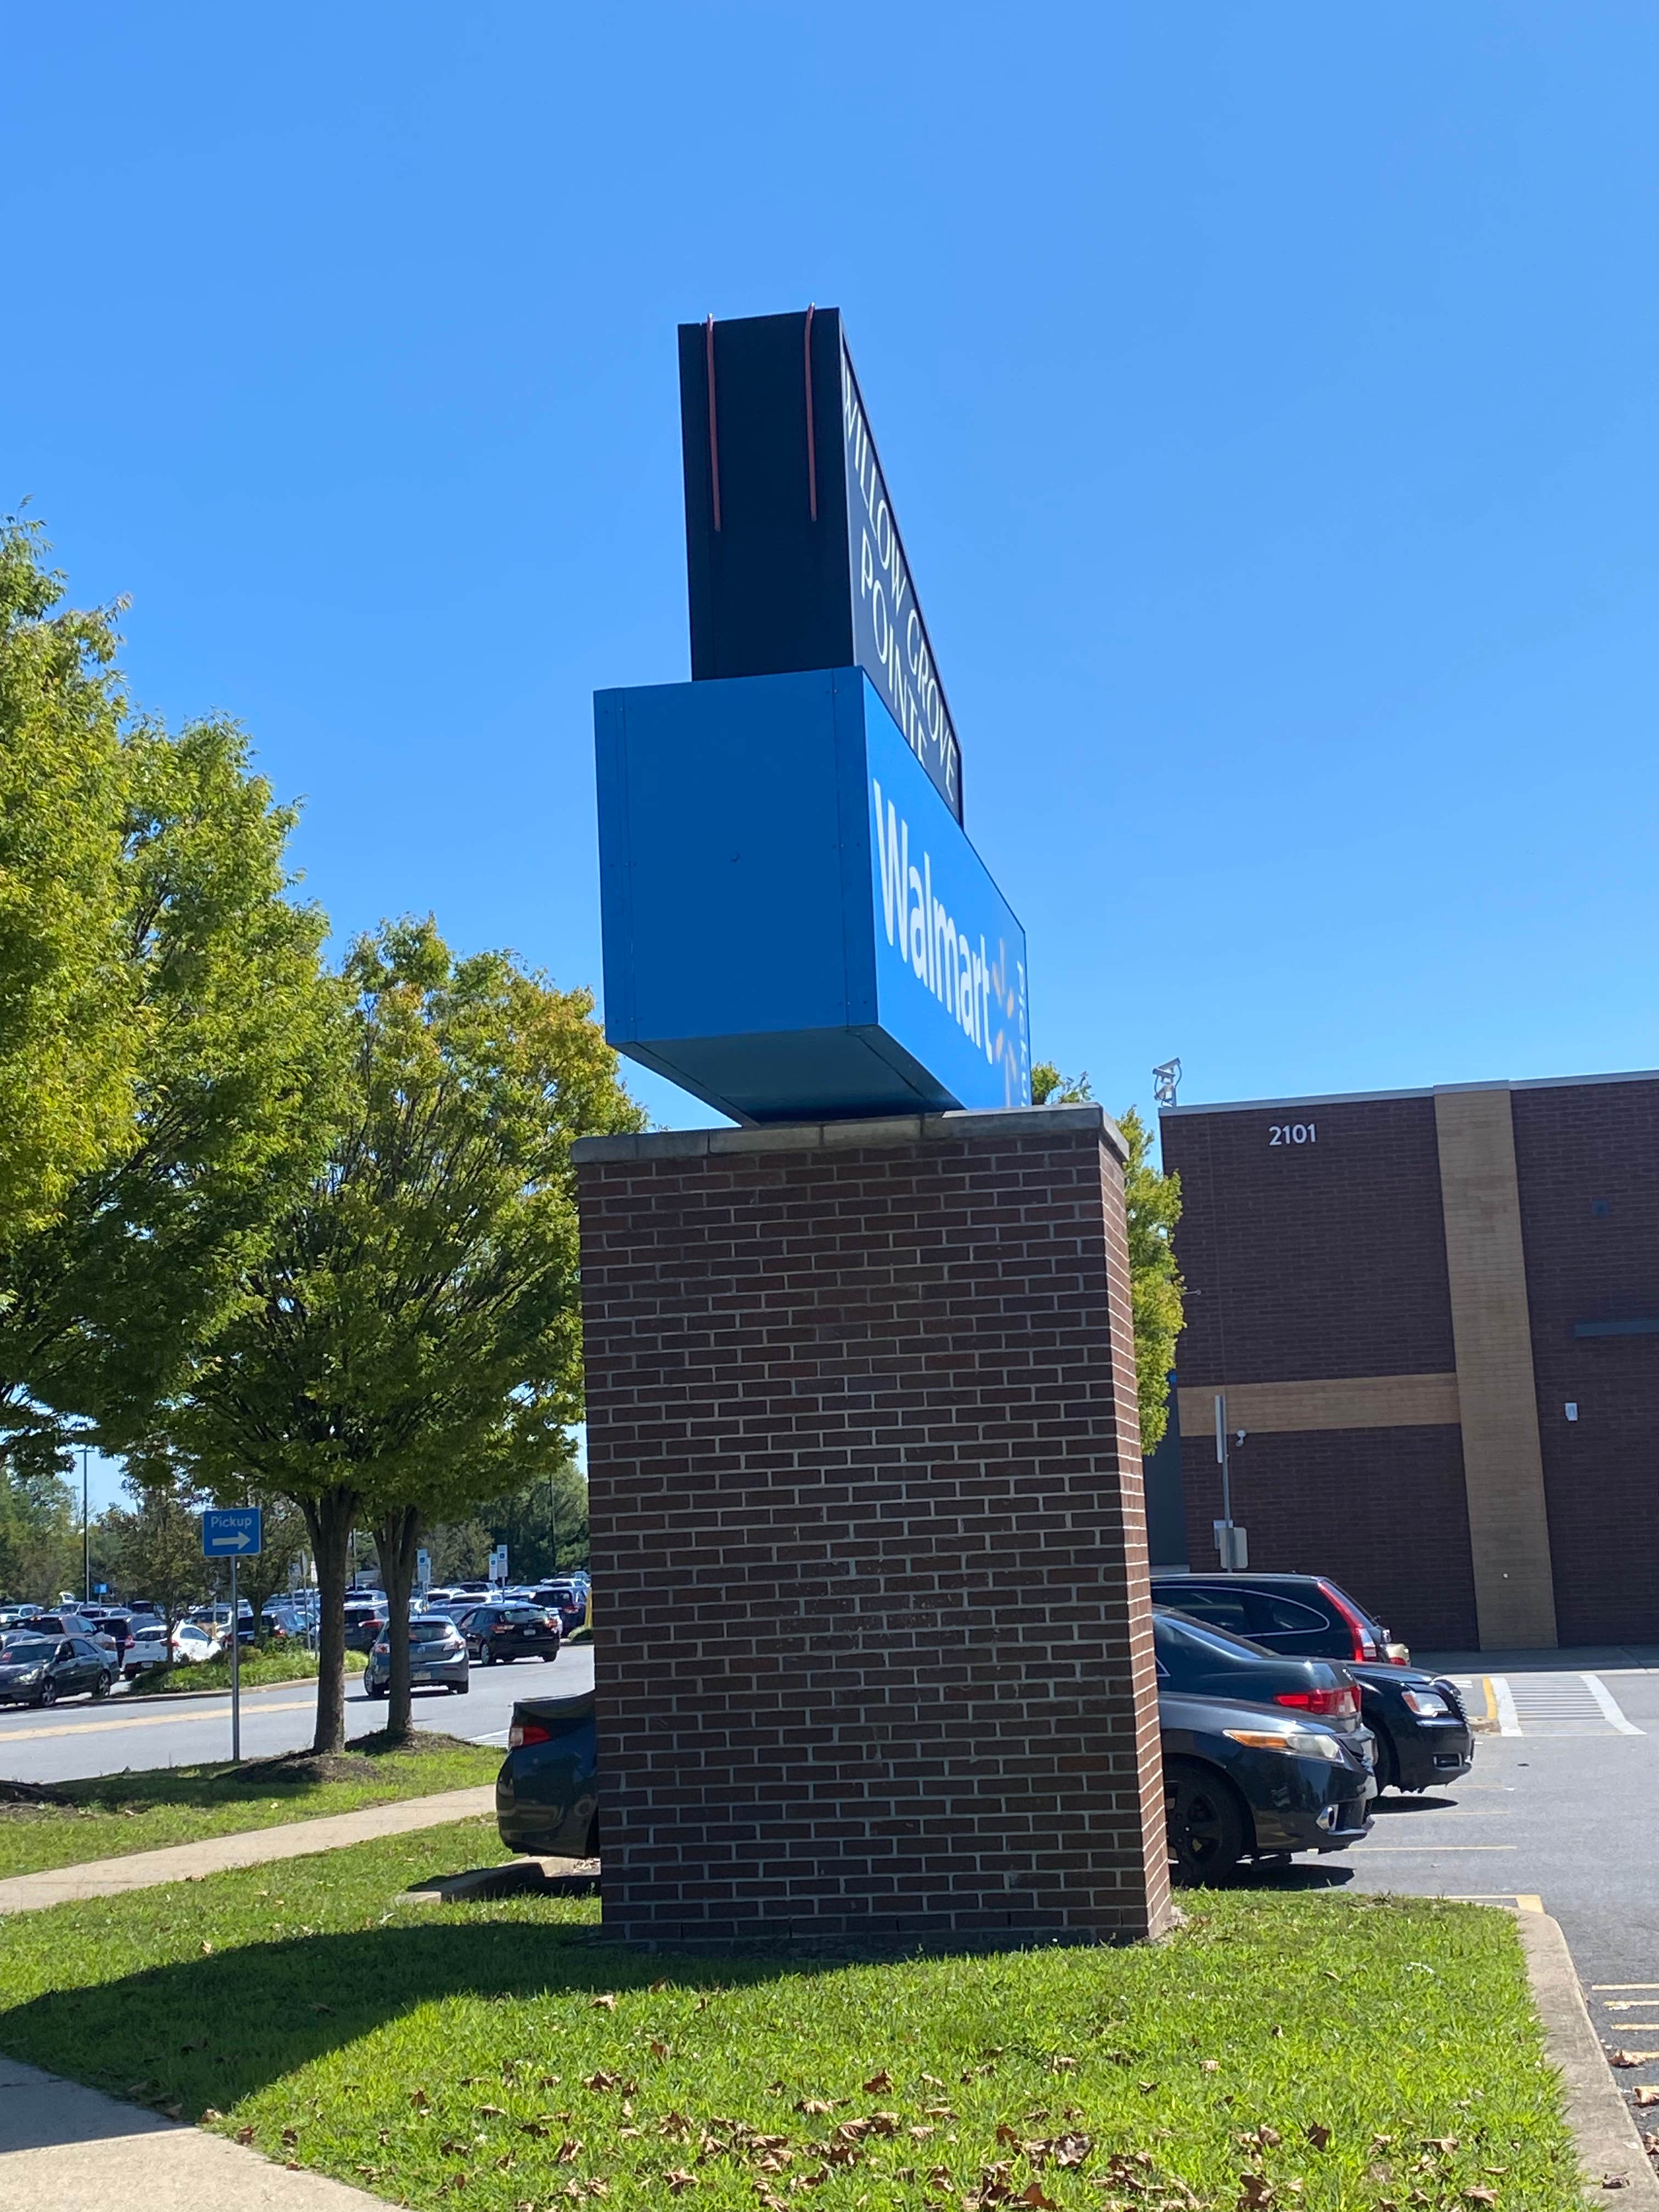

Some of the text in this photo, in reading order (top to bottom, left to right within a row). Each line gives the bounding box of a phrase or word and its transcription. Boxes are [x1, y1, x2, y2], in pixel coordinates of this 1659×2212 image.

[842, 353, 956, 802] WILLOW GROVE
[873, 777, 992, 1065] Walmart
[1017, 961, 1028, 1107] Picku
[1269, 1124, 1316, 1146] 2101
[211, 1516, 252, 1529] Pickup
